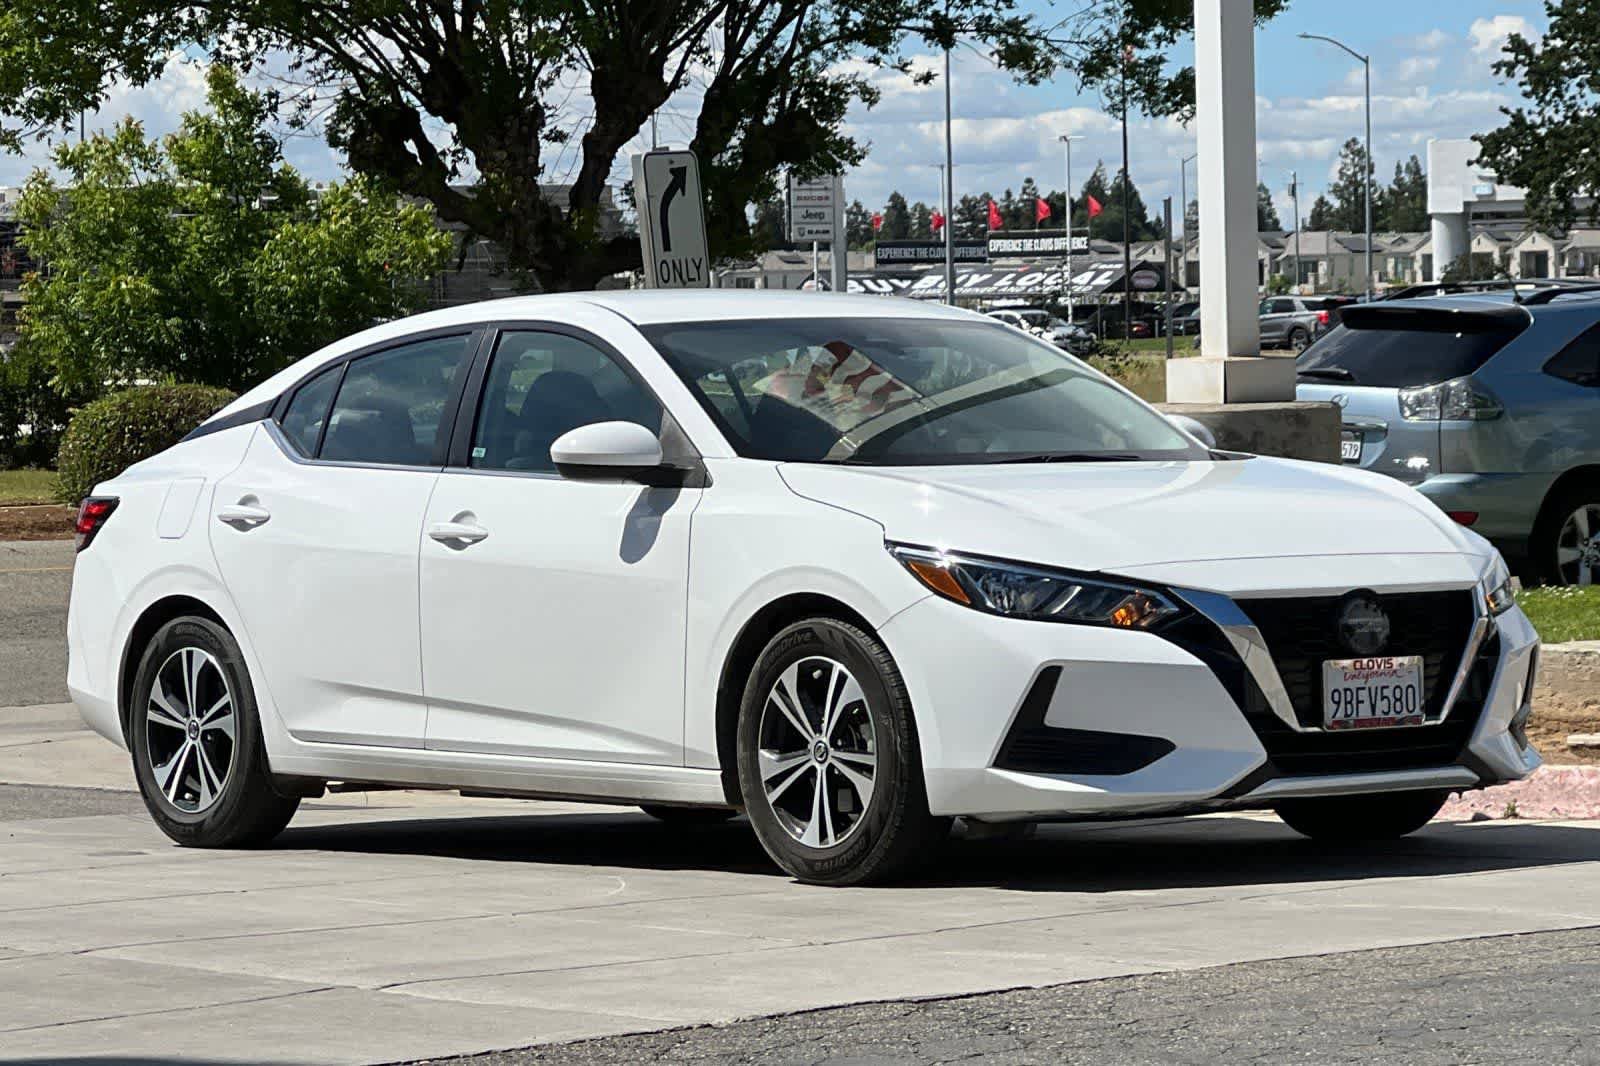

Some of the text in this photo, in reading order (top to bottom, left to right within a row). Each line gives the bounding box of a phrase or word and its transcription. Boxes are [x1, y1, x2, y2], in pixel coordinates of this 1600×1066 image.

[801, 209, 825, 220] Jeep
[989, 236, 1088, 252] EXPERIENCE THE CLOVIS DIFFRENCE
[877, 247, 916, 259] EXPERIENCE
[916, 247, 928, 259] THE
[659, 257, 704, 286] ONLY
[993, 271, 1115, 287] LOCAL
[1353, 658, 1394, 671] CLOVIS
[1343, 669, 1405, 684] California
[1331, 684, 1417, 719] 9BFV580
